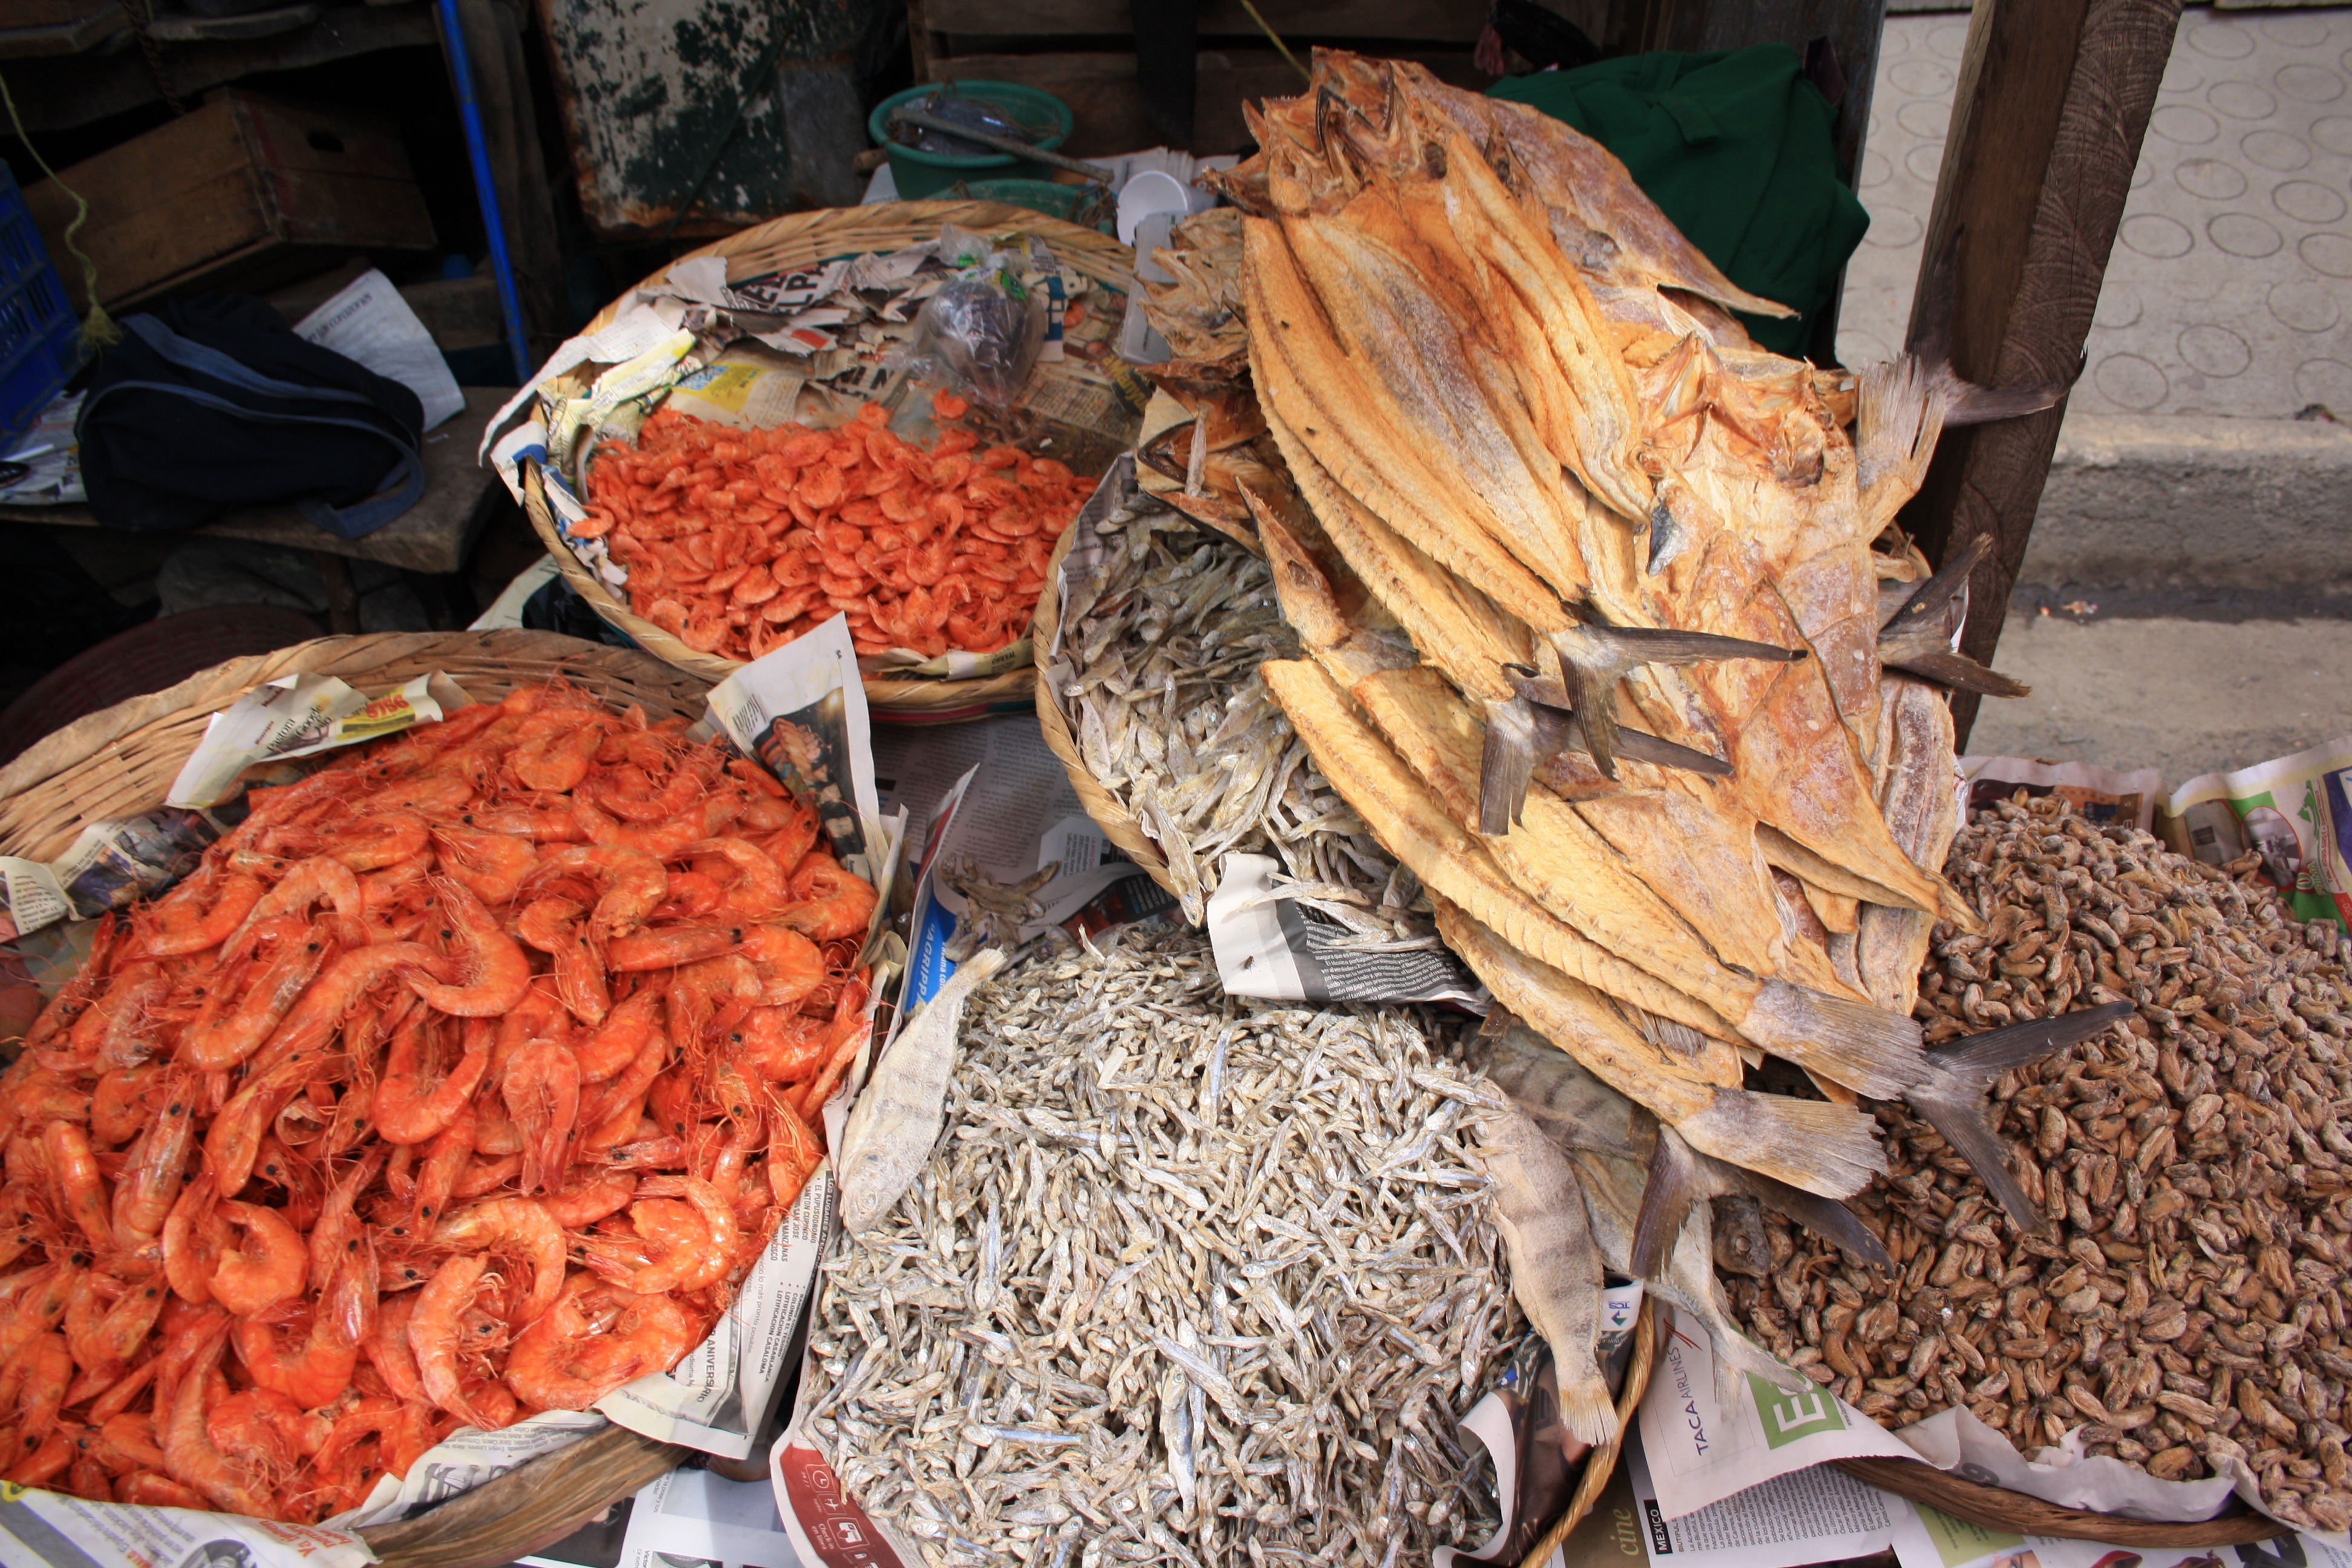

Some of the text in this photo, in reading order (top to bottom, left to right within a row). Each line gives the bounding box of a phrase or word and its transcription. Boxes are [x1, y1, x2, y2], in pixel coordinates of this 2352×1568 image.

[808, 1192, 822, 1243] PUPUSODROMO
[823, 1195, 831, 1230] LUGARES
[790, 1222, 800, 1239] JOSE
[753, 1301, 762, 1325] pronto
[785, 1292, 798, 1322] COLONIA
[759, 1290, 782, 1374] LOTIFICACION CASALOMA
[765, 1292, 790, 1382] LOTIFICACION CASABLANCA
[1668, 1347, 1709, 1455] TACA AIRLINES
[1771, 1483, 1780, 1500] poder
[1737, 1497, 1746, 1512] haber
[1754, 1503, 1765, 1526] destinos
[1787, 1509, 1793, 1518] de
[1789, 1492, 1802, 1518] estrenarse
[1816, 1503, 1824, 1515] más
[1861, 1500, 1874, 1525] laberinto
[1717, 1509, 1728, 1532] Bardem
[1749, 1510, 1759, 1530] ciudad
[1773, 1515, 1783, 1534] buscó
[1791, 1518, 1800, 1539] normas
[1797, 1518, 1809, 1539] debido
[1843, 1515, 1853, 1534] primer
[1880, 1509, 1889, 1527] Carlos
[812, 1526, 818, 1534] en
[1610, 1508, 1638, 1557] cine
[1651, 1509, 1668, 1552] MEXICO
[1735, 1514, 1748, 1546] nacional en
[1743, 1518, 1756, 1546] selección
[1757, 1536, 1762, 1545] de
[1764, 1535, 1771, 1544] de
[1808, 1523, 1817, 1538] pero
